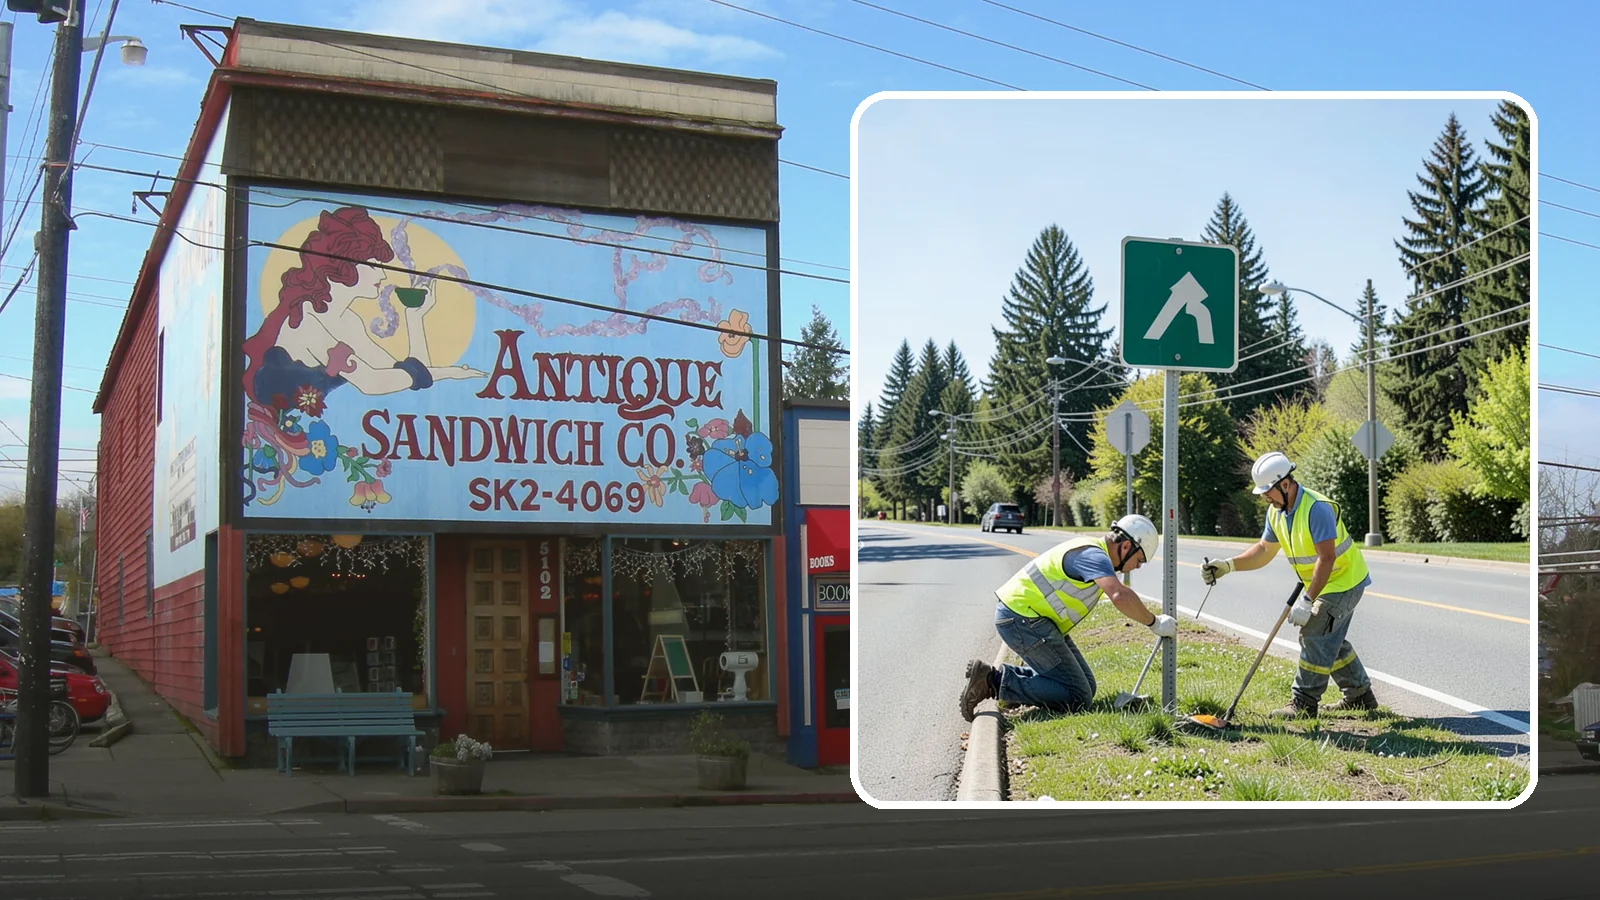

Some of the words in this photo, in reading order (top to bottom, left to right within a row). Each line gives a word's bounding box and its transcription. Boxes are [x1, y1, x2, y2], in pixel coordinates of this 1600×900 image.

[476, 329, 723, 421] ANTIQUE
[362, 409, 603, 467] SANDWICH
[617, 421, 685, 469] CO.
[469, 477, 645, 513] SK2-4069
[539, 542, 551, 599] 5102
[809, 555, 834, 568] BOOKS
